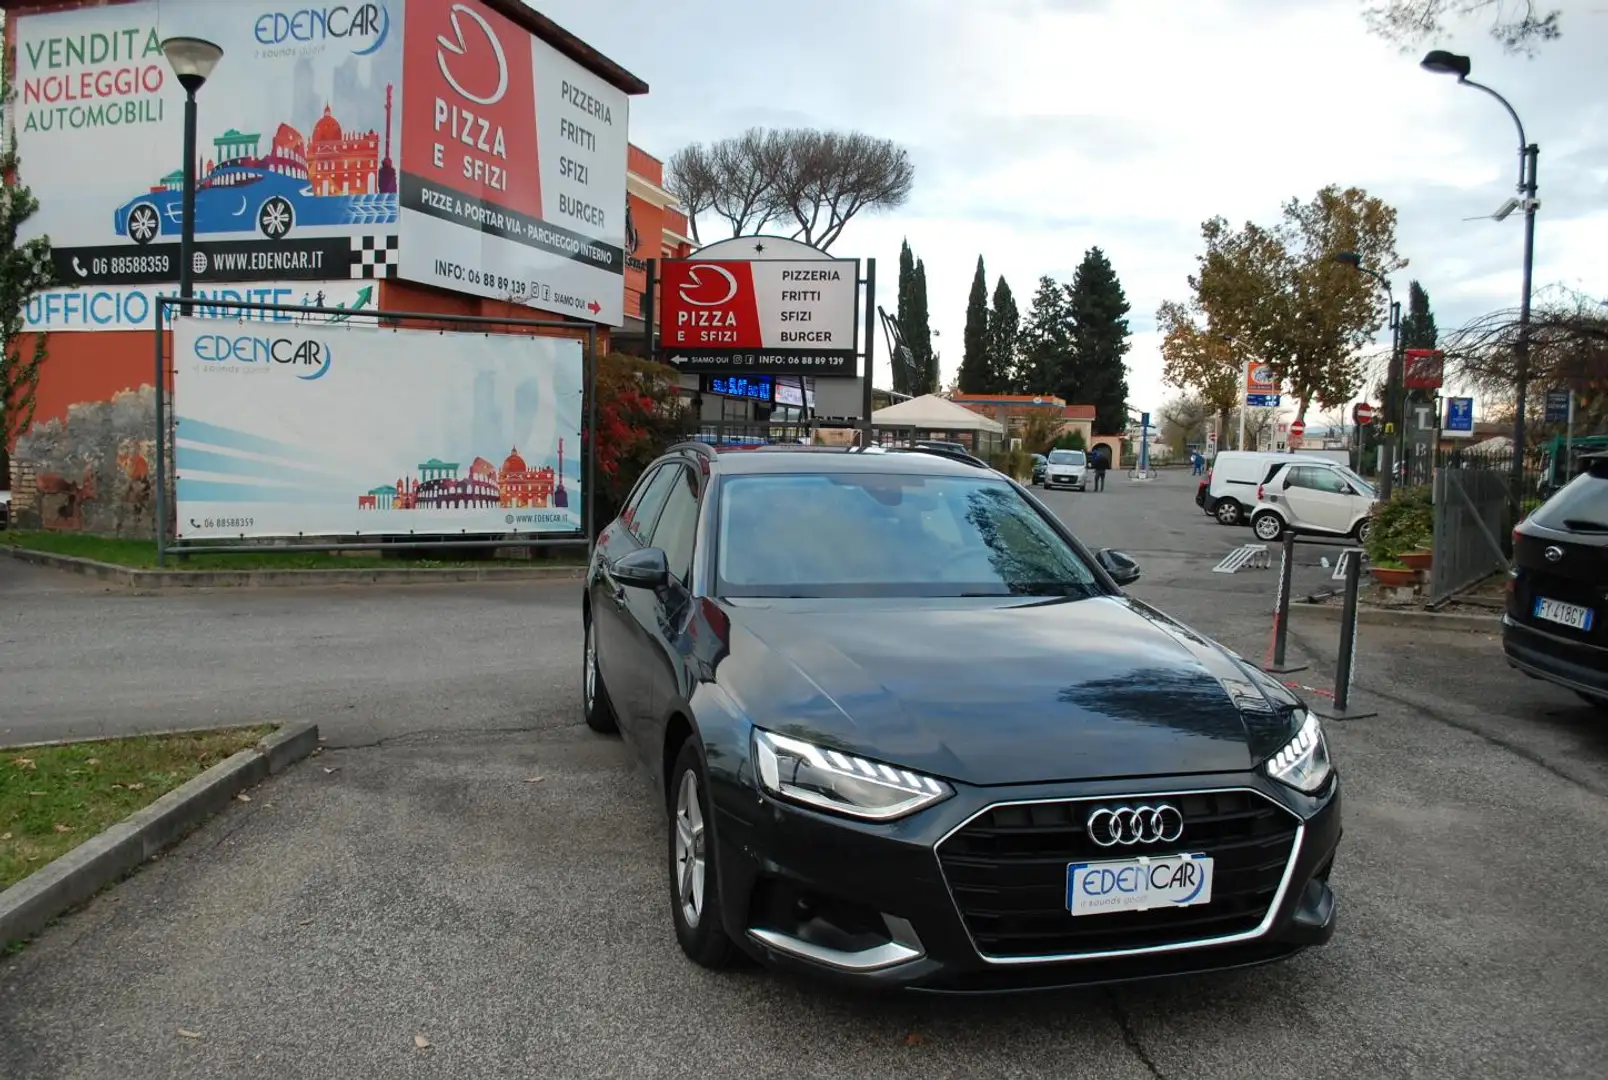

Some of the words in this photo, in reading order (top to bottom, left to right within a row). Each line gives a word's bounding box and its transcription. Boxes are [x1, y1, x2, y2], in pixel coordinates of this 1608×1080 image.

[254, 4, 379, 44] EDENCAR
[26, 27, 163, 70] VENDITA
[24, 65, 163, 105] NOLEGGIO
[24, 99, 163, 132] AUTOMOBILI
[561, 80, 612, 126] PIZZERIA
[435, 97, 506, 160] PIZZA
[560, 119, 596, 152] FRITTI
[434, 143, 444, 168] E
[463, 156, 507, 191] SFIZI
[560, 156, 588, 186] SFIZI
[421, 188, 453, 212] PIZZE
[454, 199, 463, 216] A
[464, 203, 504, 228] PORTAR
[505, 216, 521, 235] VIA
[527, 225, 580, 252] PARCHEGGIO
[580, 246, 613, 265] INTERNO
[559, 194, 605, 229] BURGER
[93, 257, 108, 275] 06
[111, 255, 169, 274] 88588359
[213, 251, 324, 271] WWW.EDENCAR.IT
[782, 270, 840, 281] PIZZERIA
[435, 259, 465, 281] INFO:
[468, 270, 480, 284] 06
[483, 274, 495, 288] 88
[497, 277, 508, 291] 89
[511, 280, 526, 295] 139
[25, 291, 149, 326] UFFICIO
[554, 292, 573, 306] SIAMO
[782, 290, 821, 301] FRITTI
[678, 311, 737, 326] PIZZA
[781, 311, 812, 322] SFIZI
[194, 335, 322, 365] EDENCAR
[678, 331, 685, 342] E
[701, 330, 737, 342] SFIZI
[781, 331, 832, 342] BURGER
[691, 356, 715, 364] SIAMO
[716, 356, 729, 365] QUI
[759, 355, 786, 365] INFO:
[788, 356, 799, 365] 06
[802, 356, 812, 365] 88
[815, 356, 825, 365] 89
[829, 357, 844, 366] 139
[204, 518, 214, 528] 06
[1083, 862, 1196, 896] EDENCAR
